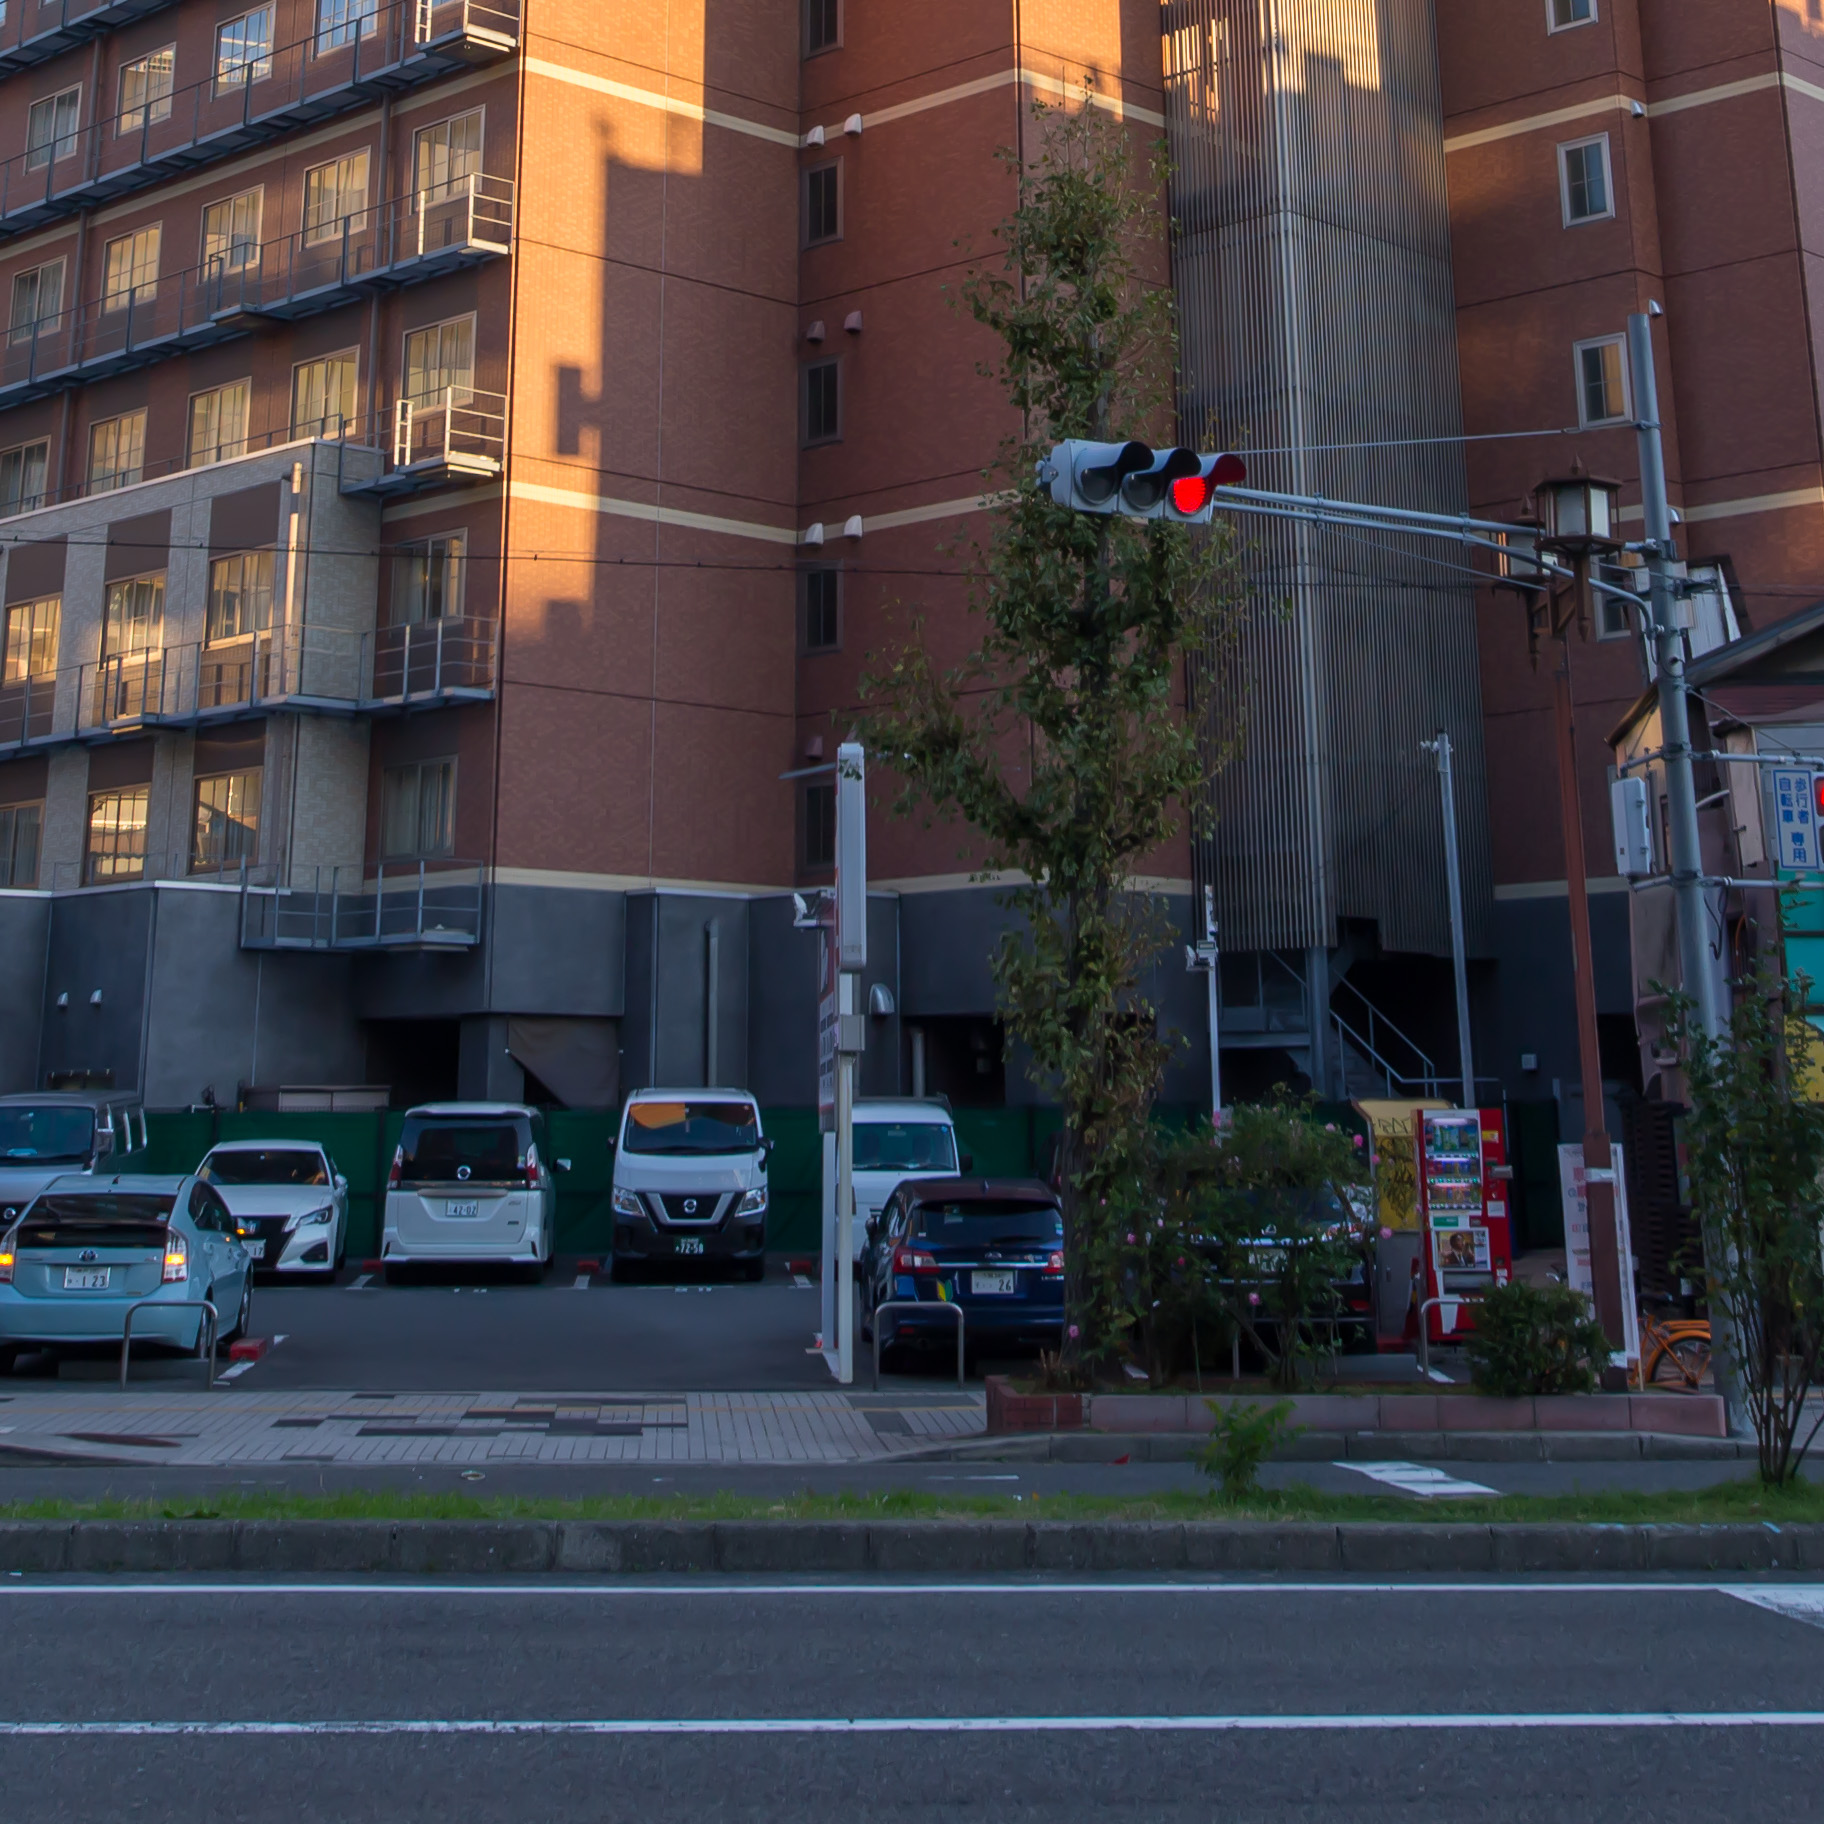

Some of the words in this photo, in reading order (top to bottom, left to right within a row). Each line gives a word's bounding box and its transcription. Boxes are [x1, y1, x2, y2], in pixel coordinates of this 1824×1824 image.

[1778, 777, 1795, 824] 自転車
[1794, 777, 1810, 825] 歩行者
[1790, 831, 1808, 864] 専用
